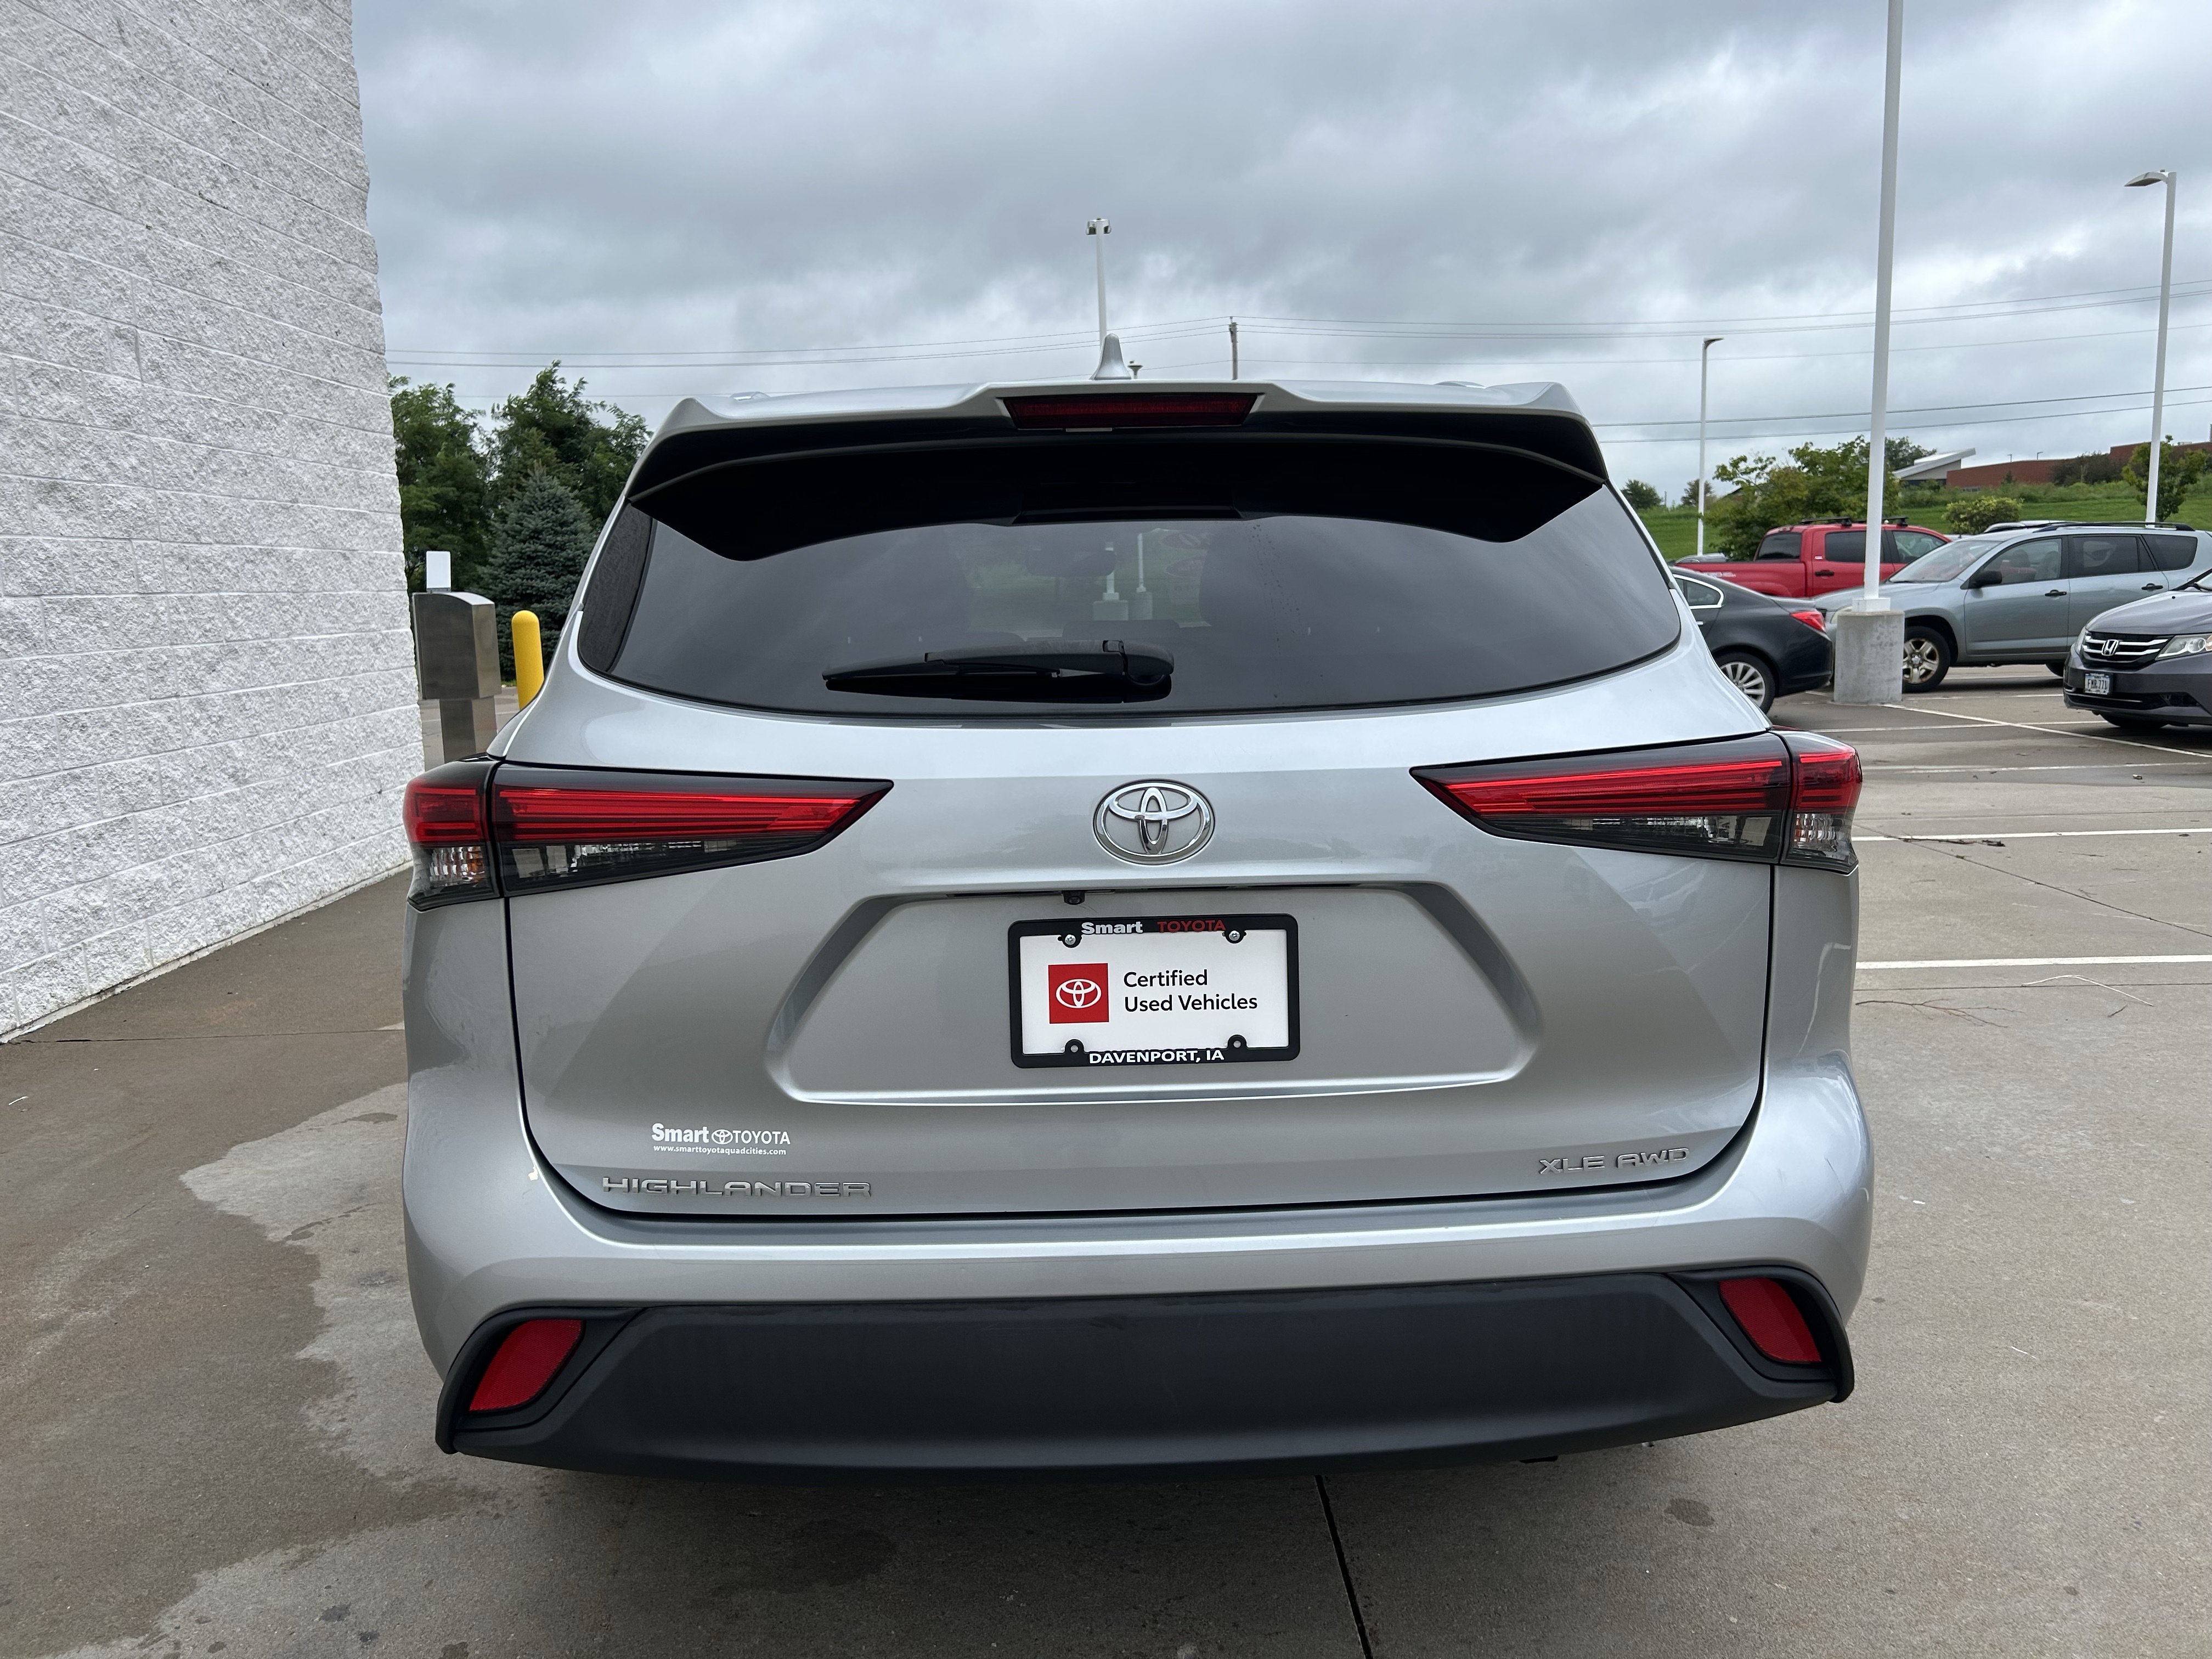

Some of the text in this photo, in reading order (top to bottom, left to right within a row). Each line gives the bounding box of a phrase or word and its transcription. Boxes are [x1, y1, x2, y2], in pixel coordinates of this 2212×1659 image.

[1081, 919, 1226, 935] Smart TOYOTA
[1123, 969, 1208, 988] Certified
[1125, 993, 1258, 1012] Used Vehicles
[1089, 1049, 1224, 1064] DAVENPORT, IA
[651, 1122, 791, 1145] Smart TOYOTA
[653, 1144, 787, 1156] www.smarttoyotaquadcities.com
[1538, 1147, 1690, 1175] XLE AWD
[602, 1176, 872, 1198] HIGHLANDER
